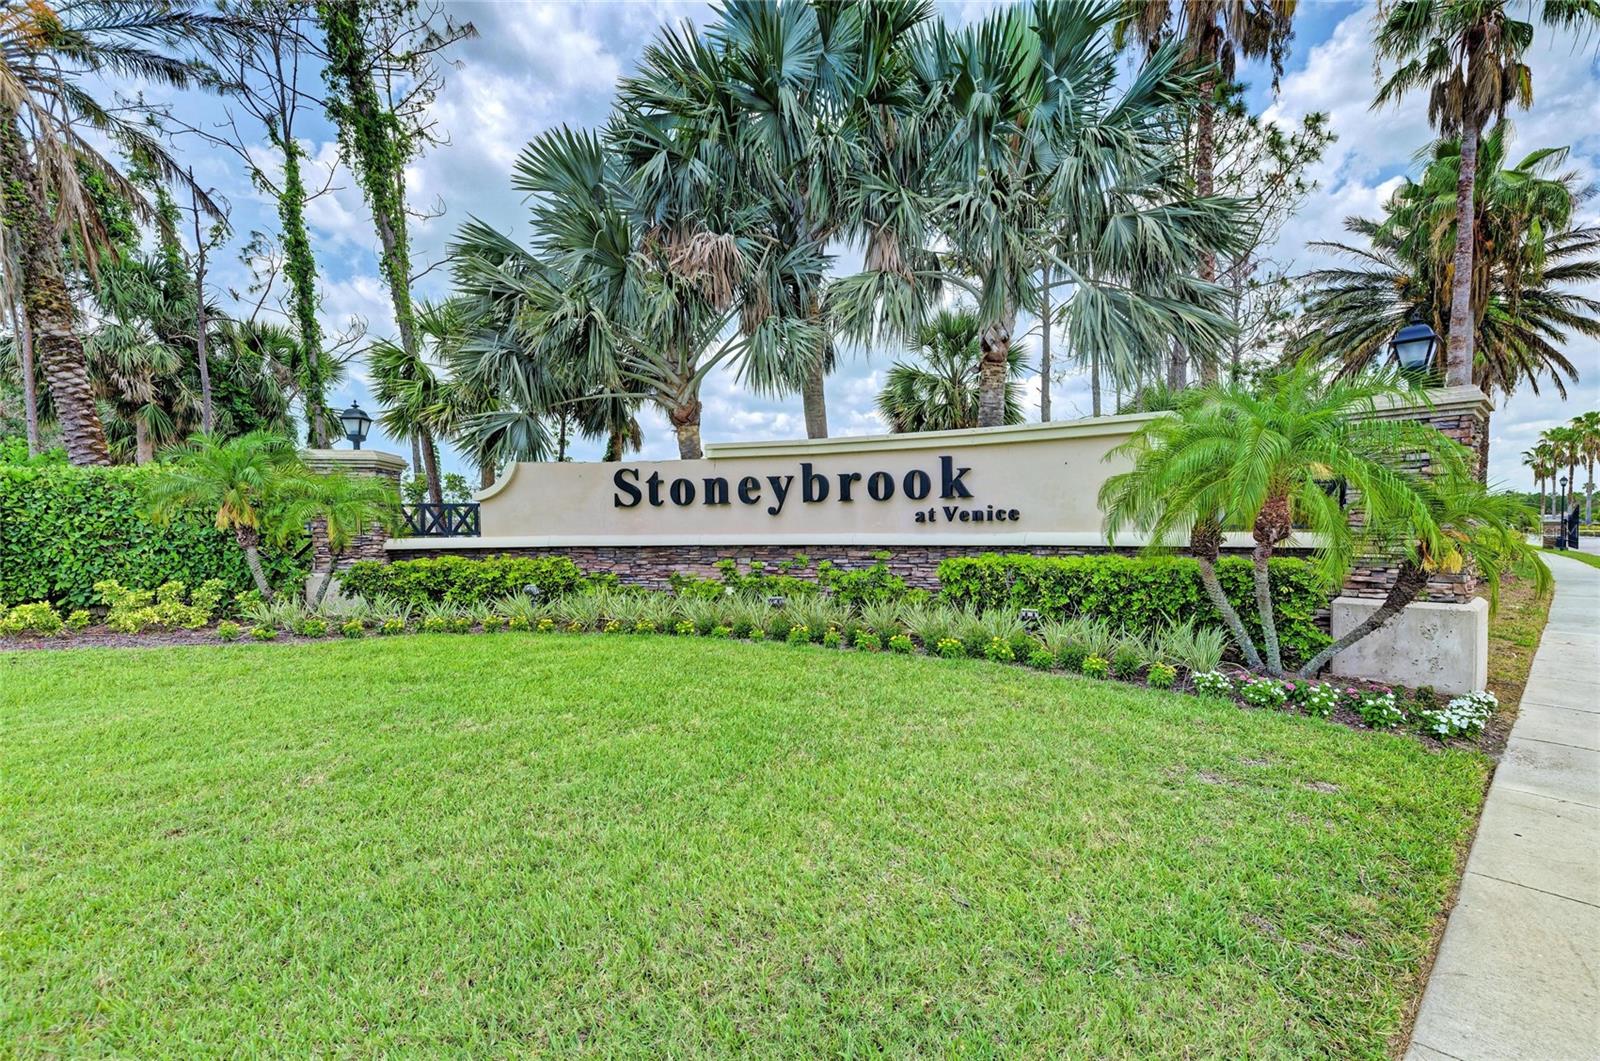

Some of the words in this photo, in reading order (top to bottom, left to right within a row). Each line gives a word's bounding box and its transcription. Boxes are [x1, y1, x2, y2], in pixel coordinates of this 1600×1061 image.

[613, 455, 975, 517] Stoneybrook
[914, 507, 937, 524] at
[942, 504, 1021, 523] Venice
